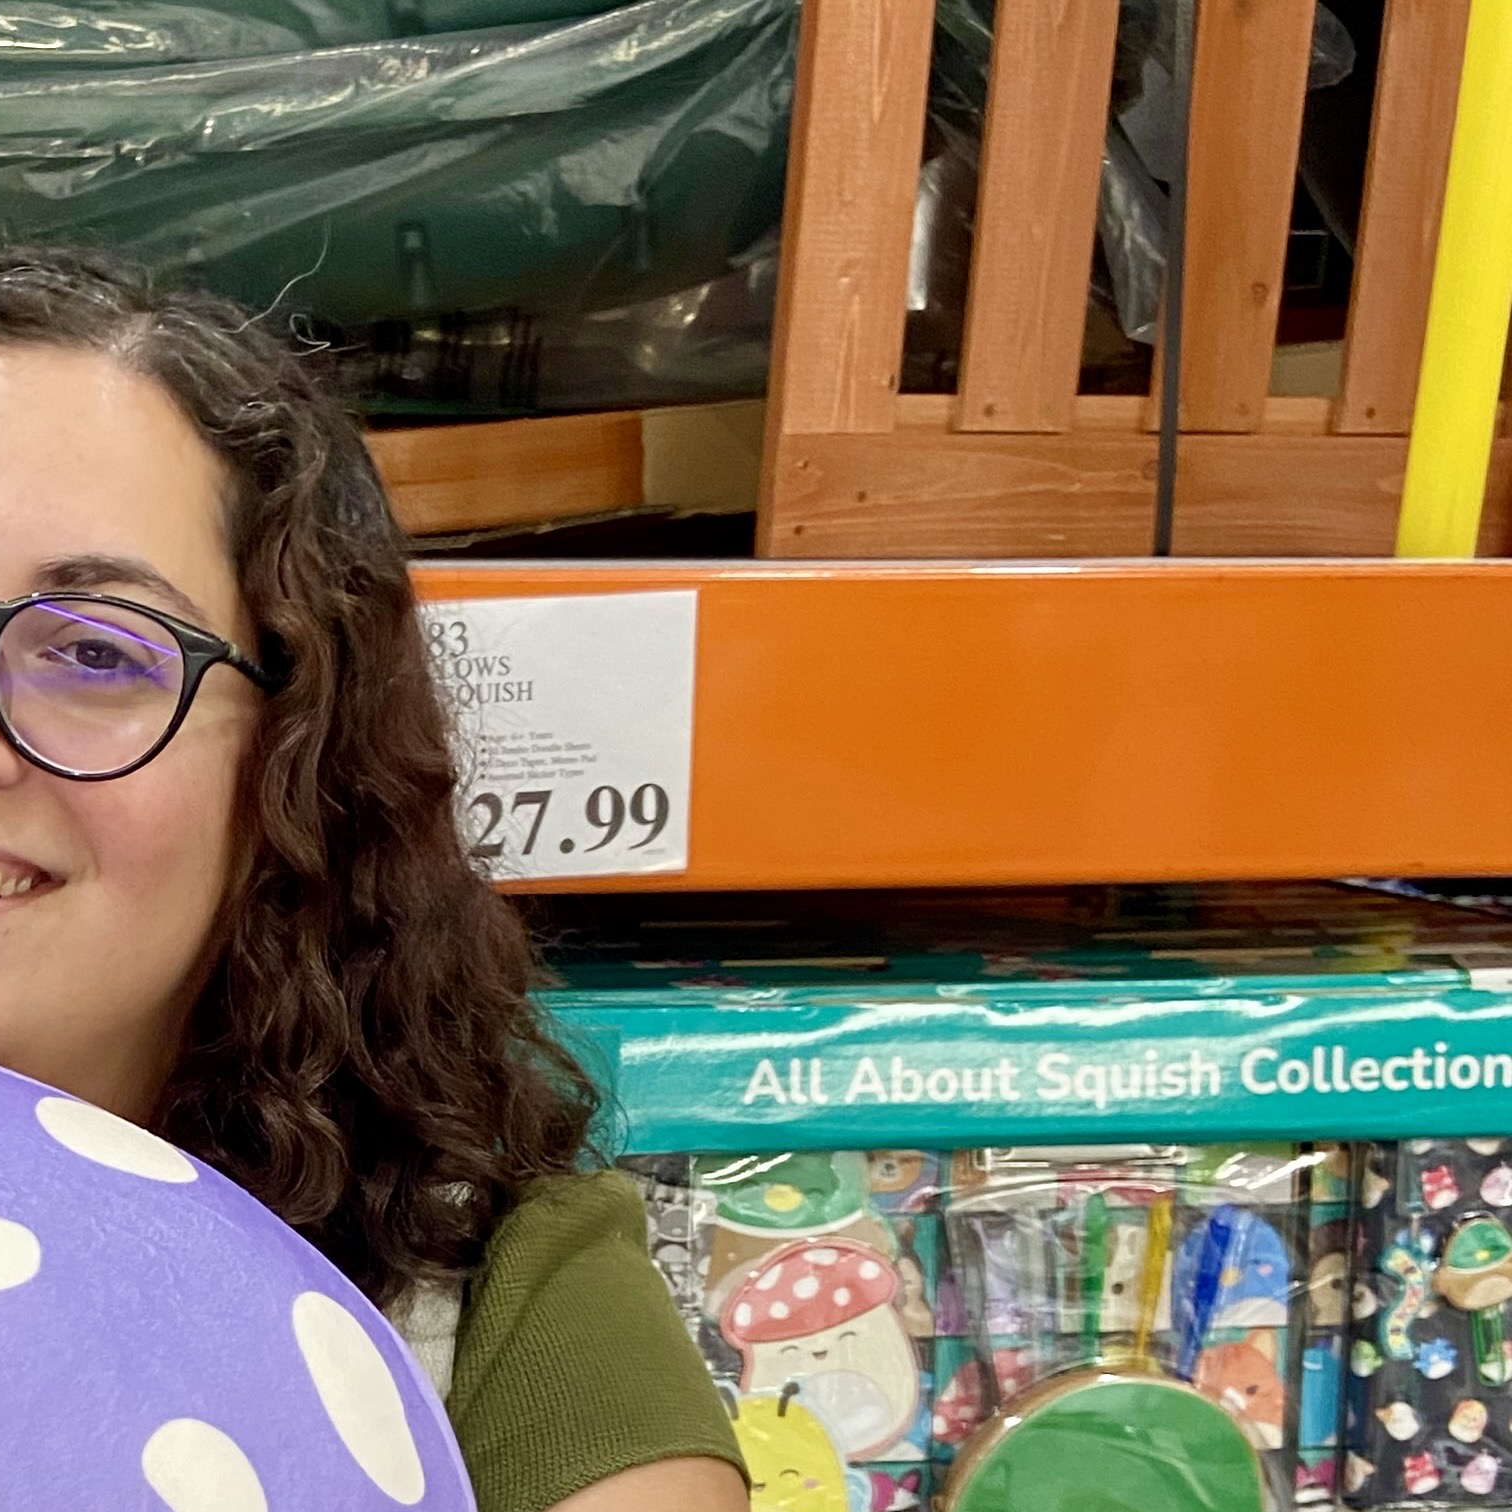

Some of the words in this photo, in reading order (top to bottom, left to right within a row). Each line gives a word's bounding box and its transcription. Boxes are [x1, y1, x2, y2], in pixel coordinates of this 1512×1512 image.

[428, 621, 469, 658] 83
[437, 656, 511, 681] LOWS
[446, 680, 534, 707] QUISH
[465, 783, 670, 857] 27.99
[743, 1056, 829, 1105] All
[844, 1055, 1021, 1104] About
[1035, 1049, 1222, 1110] Squish
[1240, 1041, 1512, 1095] Collection
